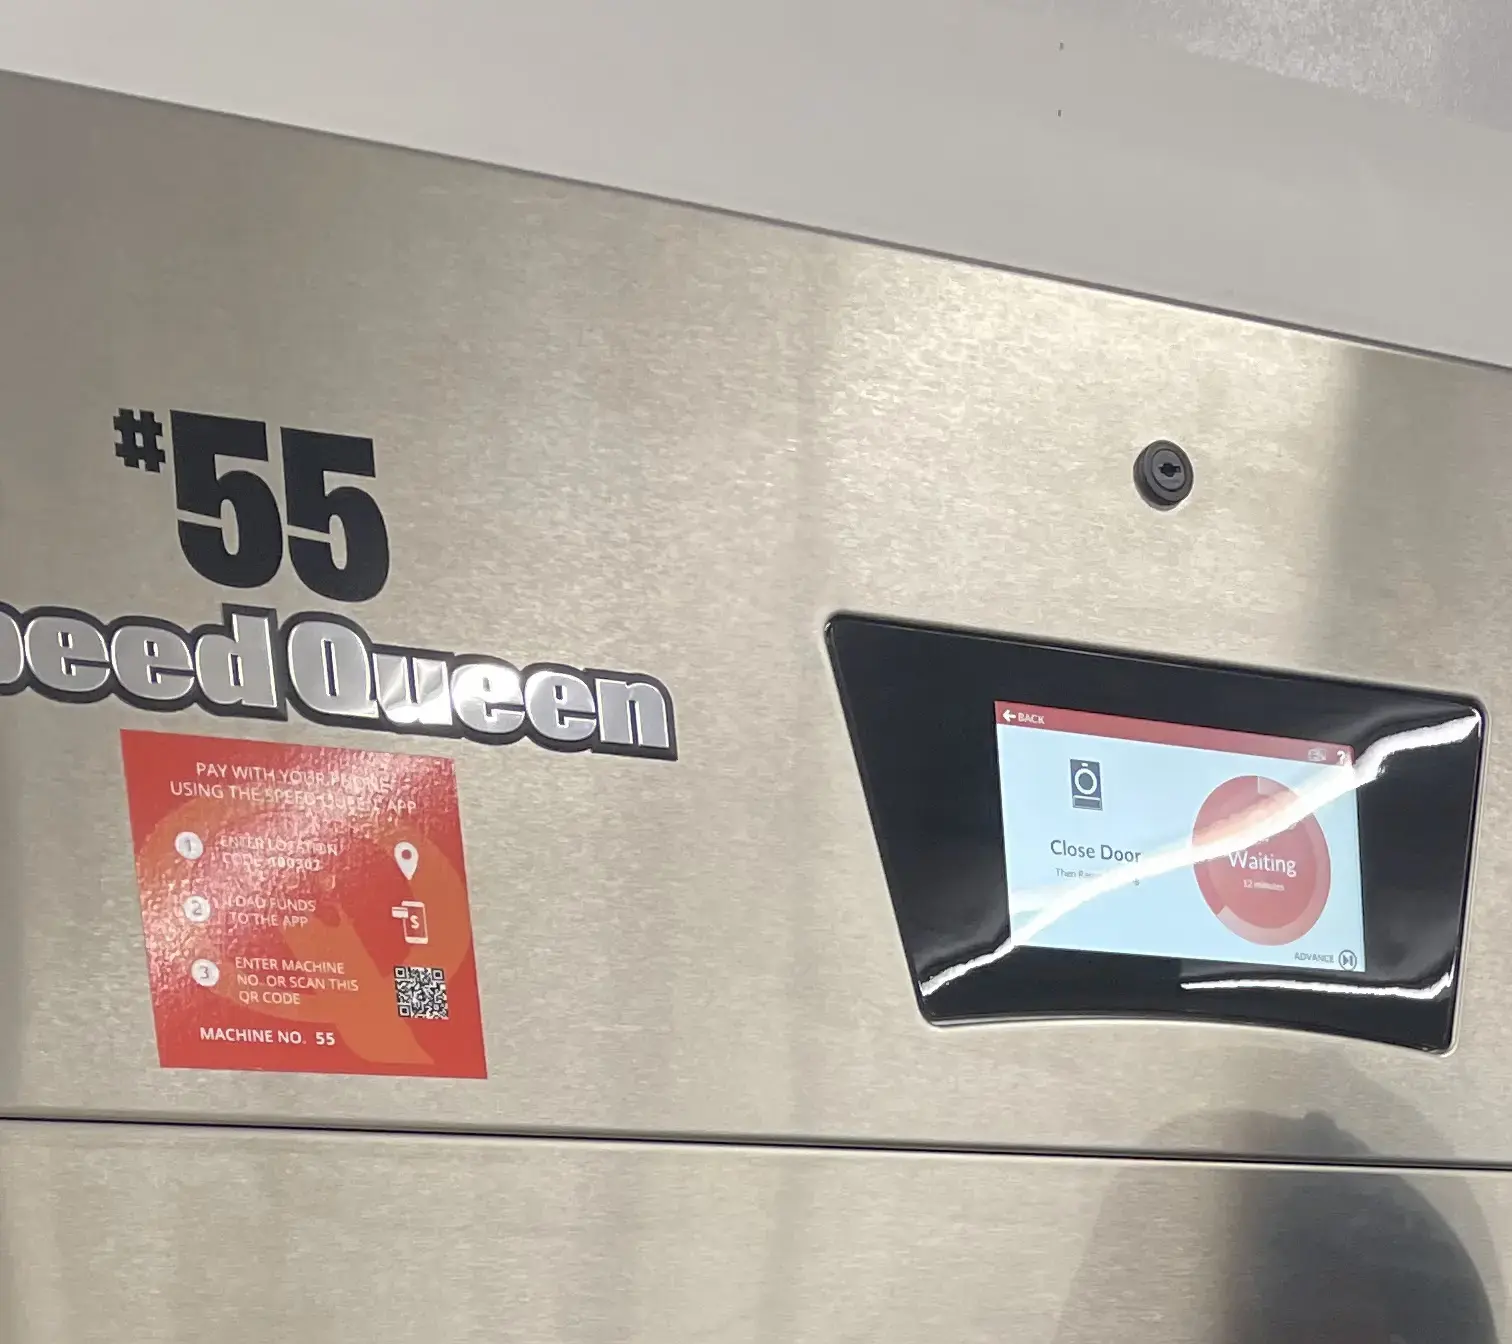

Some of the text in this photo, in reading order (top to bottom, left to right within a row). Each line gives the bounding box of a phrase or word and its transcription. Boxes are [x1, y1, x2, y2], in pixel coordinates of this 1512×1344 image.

[113, 408, 390, 601] #55
[1018, 713, 1045, 724] BACK
[196, 762, 227, 777] PAY
[231, 764, 275, 781] WITH
[279, 769, 324, 784] YOUR
[170, 781, 223, 798] USING
[229, 785, 260, 801] THE
[386, 799, 416, 814] APP
[221, 834, 264, 849] ENTER
[1051, 840, 1141, 862] Close Door
[1228, 851, 1297, 877] Waiting
[1056, 868, 1076, 878] Then
[269, 898, 316, 912] FUNDS
[231, 912, 308, 928] TO THE APP
[235, 957, 344, 974] ENTER MACHINE
[1294, 952, 1334, 964] ADVANCE
[267, 976, 285, 988] OR
[289, 976, 325, 990] SCAN
[328, 978, 358, 992] THIS
[239, 991, 300, 1005] QR CODE
[200, 1027, 335, 1045] MACHINE NO. 55
